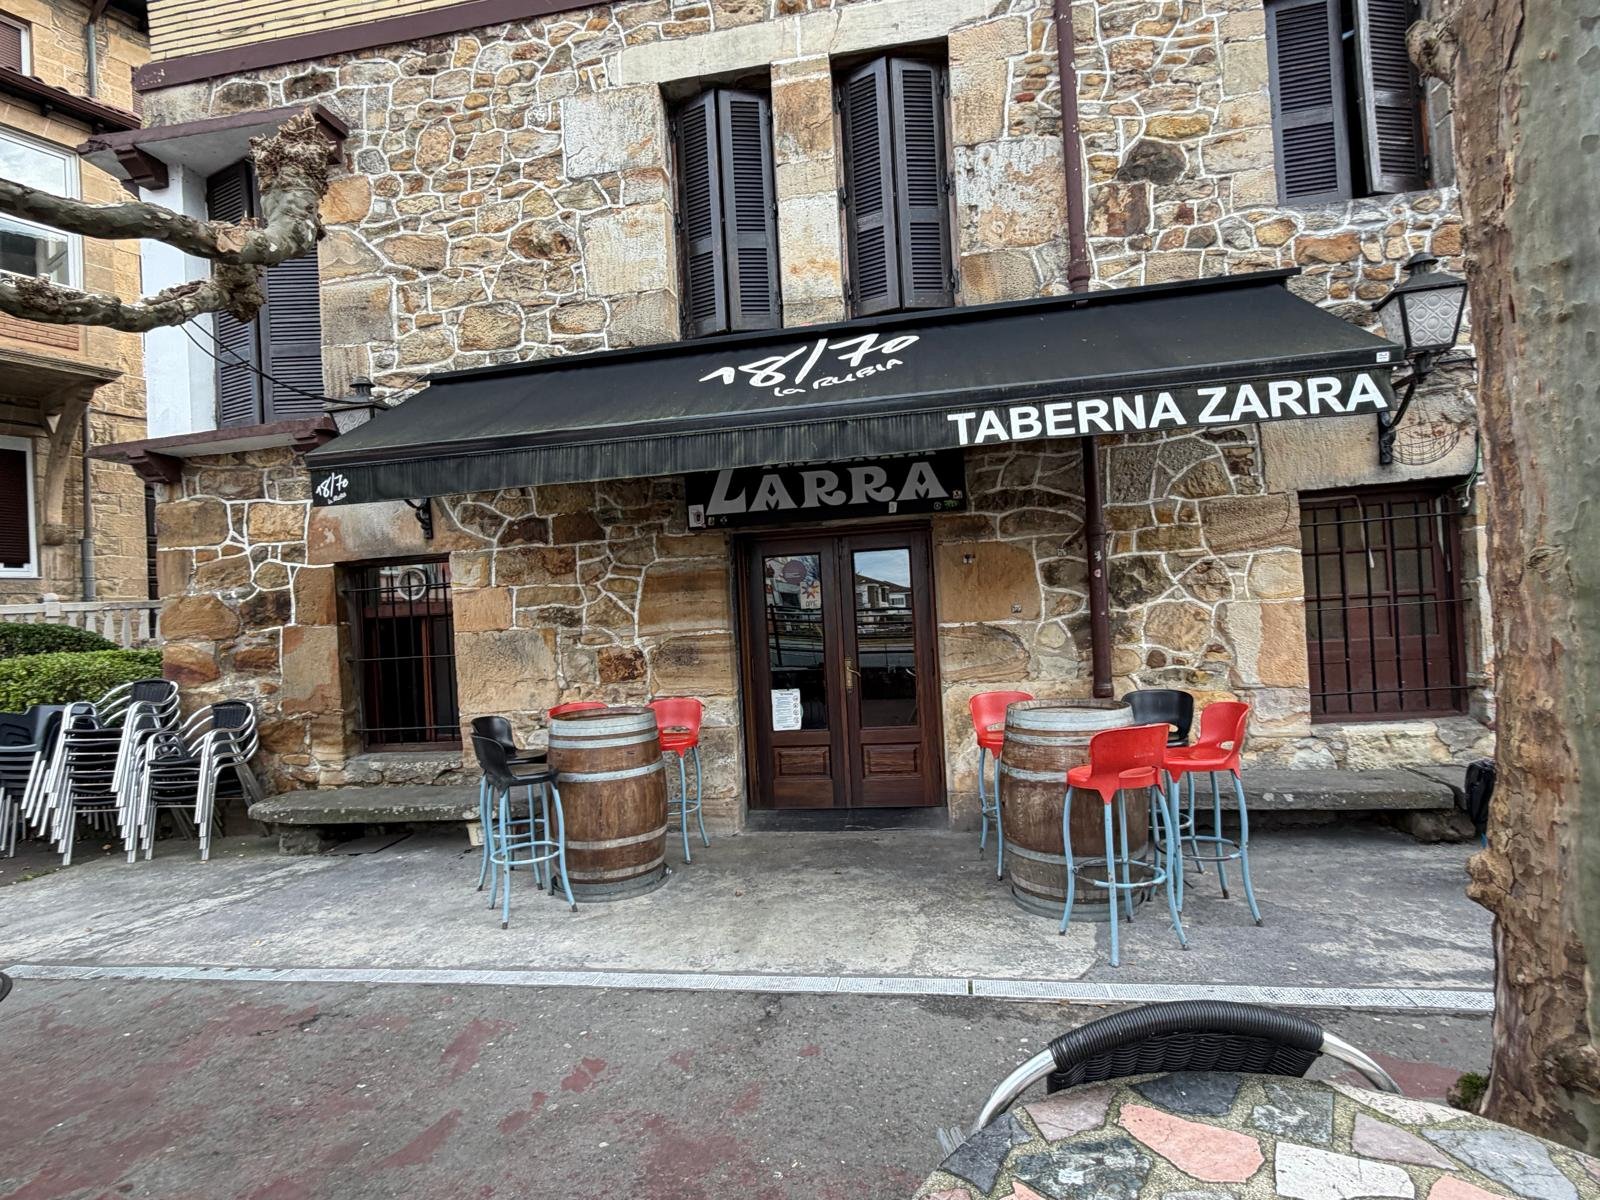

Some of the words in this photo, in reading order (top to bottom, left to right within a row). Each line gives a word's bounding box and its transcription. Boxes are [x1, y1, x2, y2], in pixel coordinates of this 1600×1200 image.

[699, 333, 920, 387] 18/70
[947, 391, 1187, 446] TABERNA
[1197, 372, 1389, 424] ZARRA
[315, 471, 349, 498] 18/70
